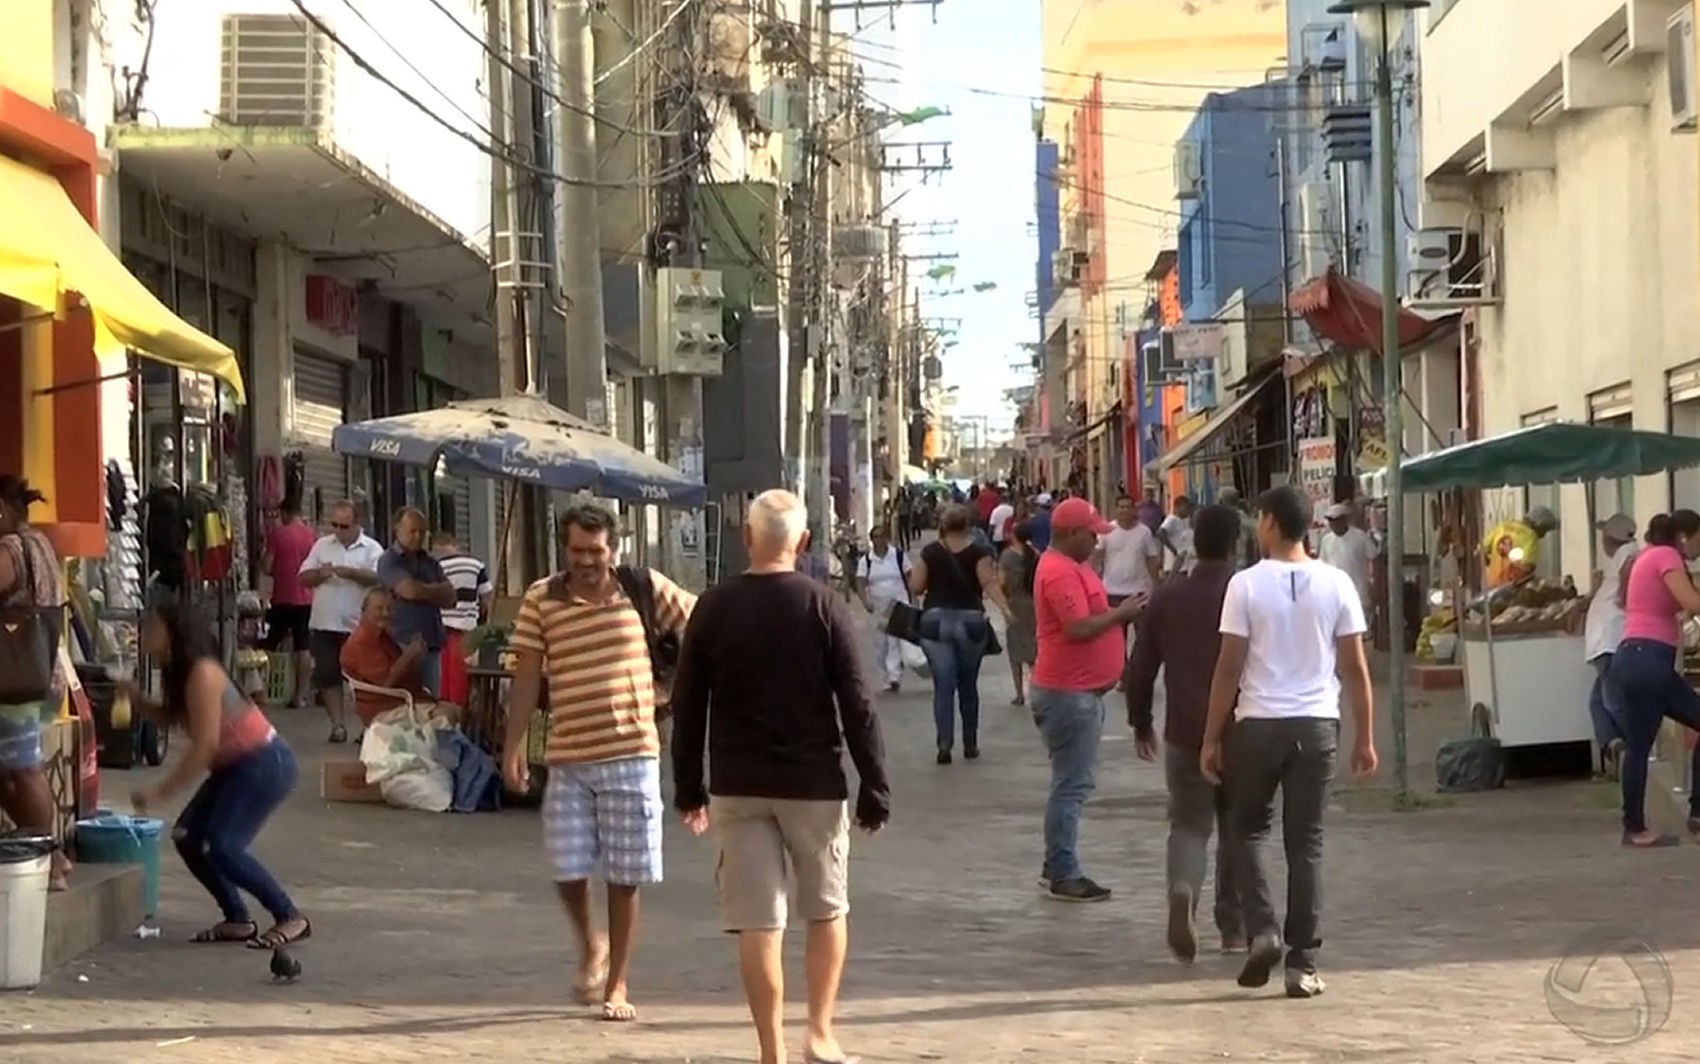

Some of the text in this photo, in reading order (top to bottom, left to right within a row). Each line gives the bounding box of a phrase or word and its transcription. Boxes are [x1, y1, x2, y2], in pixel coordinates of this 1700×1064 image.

[370, 438, 400, 456] VISA
[502, 465, 540, 479] VISA
[638, 484, 670, 501] VISA
